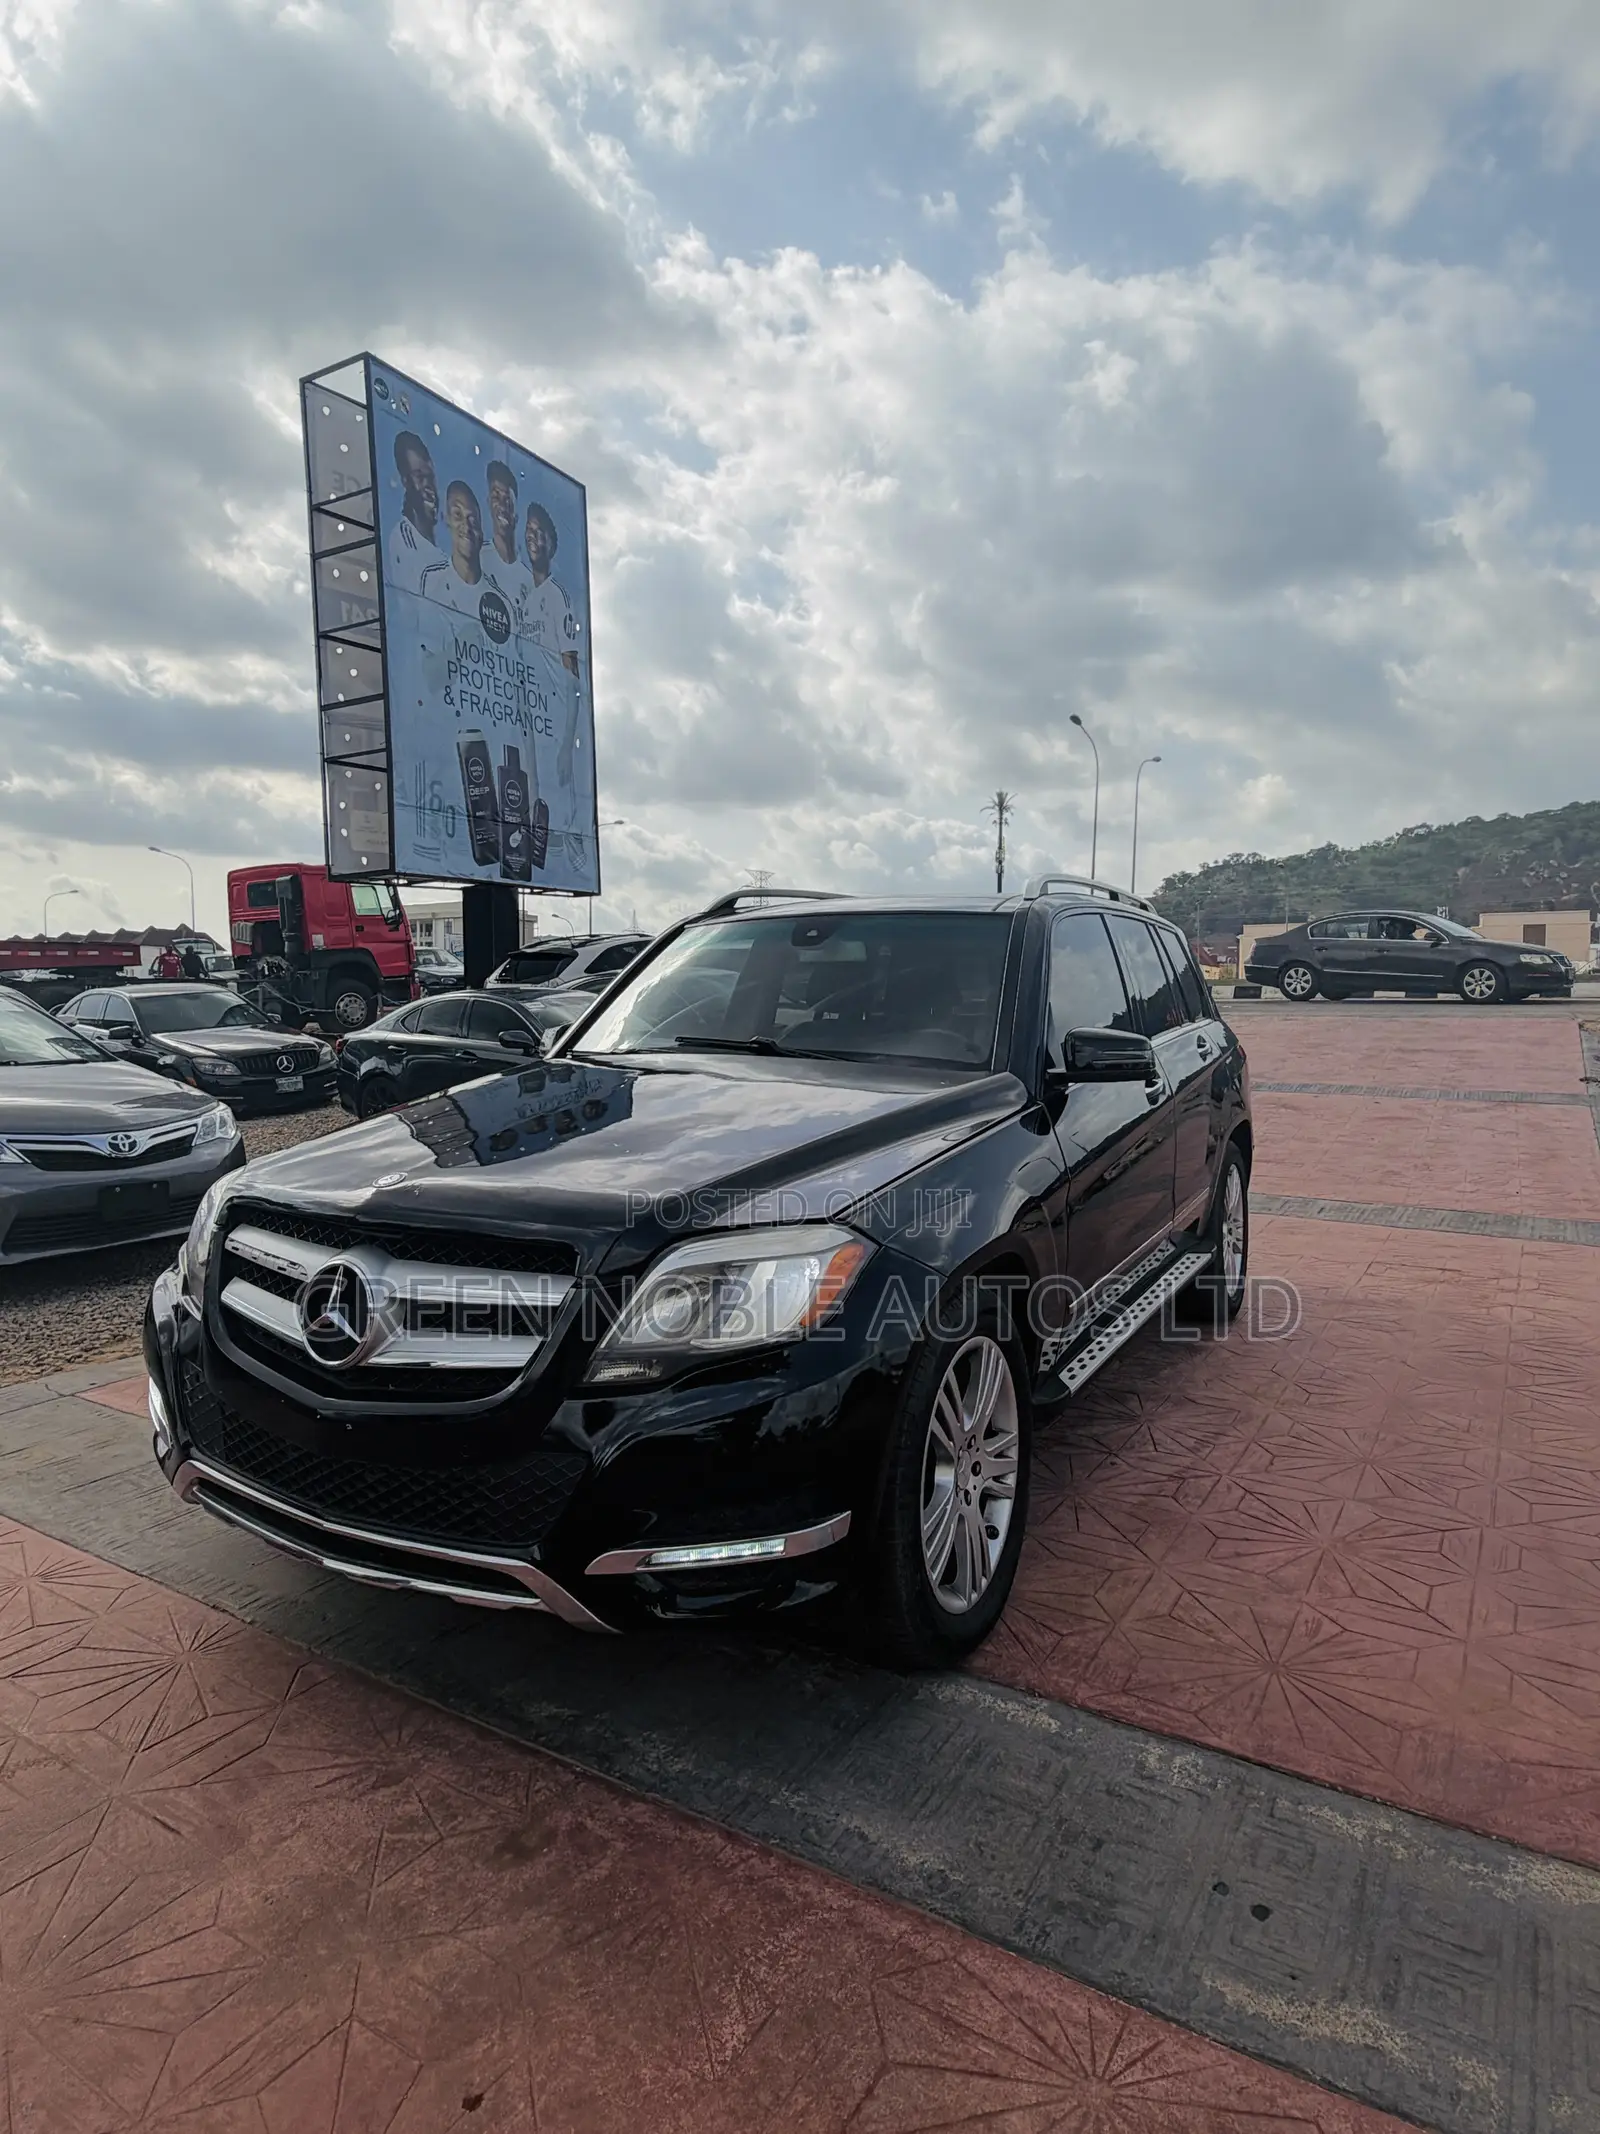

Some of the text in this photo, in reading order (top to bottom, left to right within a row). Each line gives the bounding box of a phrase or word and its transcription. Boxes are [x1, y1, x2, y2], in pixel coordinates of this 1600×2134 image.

[482, 604, 508, 625] NIVEA
[454, 636, 540, 687] MOISTURE,
[447, 660, 548, 713] PROTECTION
[444, 684, 554, 738] & FRAGRANCE
[469, 786, 490, 796] DEEP
[504, 814, 522, 823] DEEP
